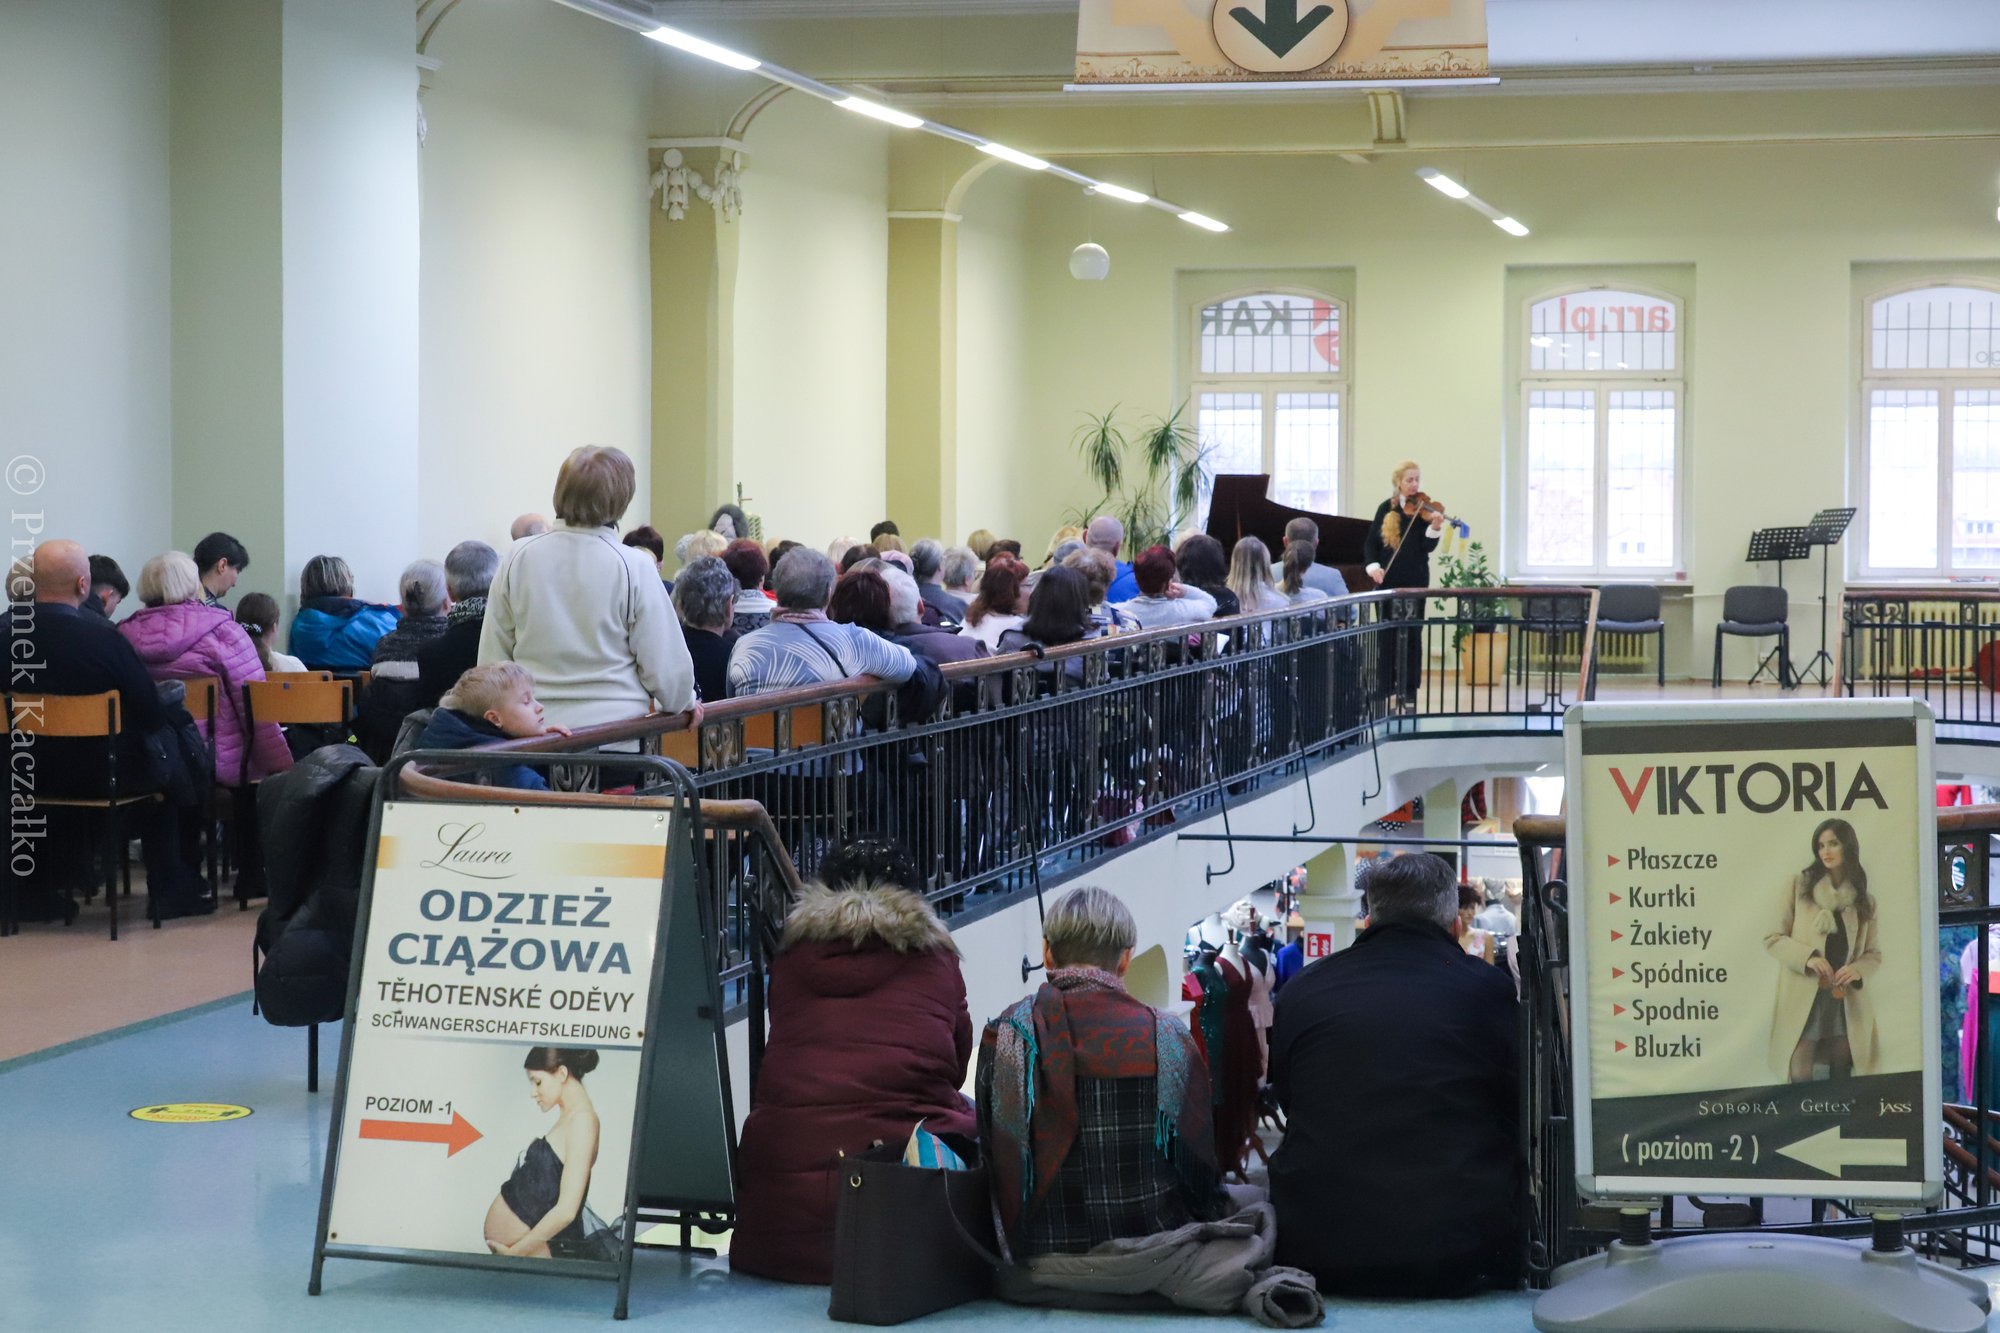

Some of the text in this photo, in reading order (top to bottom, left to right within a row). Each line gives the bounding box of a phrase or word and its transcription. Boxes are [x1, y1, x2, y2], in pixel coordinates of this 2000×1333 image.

[1608, 761, 1889, 815] VIKTORIA
[419, 822, 520, 880] Laura
[1627, 846, 1718, 870] Płaszcze
[419, 887, 612, 928] ODZIEŻ
[1629, 884, 1695, 908] Kurtki
[1630, 919, 1713, 951] Żakiety
[388, 928, 632, 976] CIĄŻOWA
[1630, 959, 1728, 989] Spódnice
[377, 977, 635, 1013] TĚHOTENSKÉ ODĚVY
[371, 1013, 632, 1040] SCHWANGERSCHAFTSKLEIDUNG
[1632, 997, 1719, 1026] Spodnie
[1635, 1034, 1701, 1058] Bluzki
[365, 1096, 452, 1115] POZIOM -1
